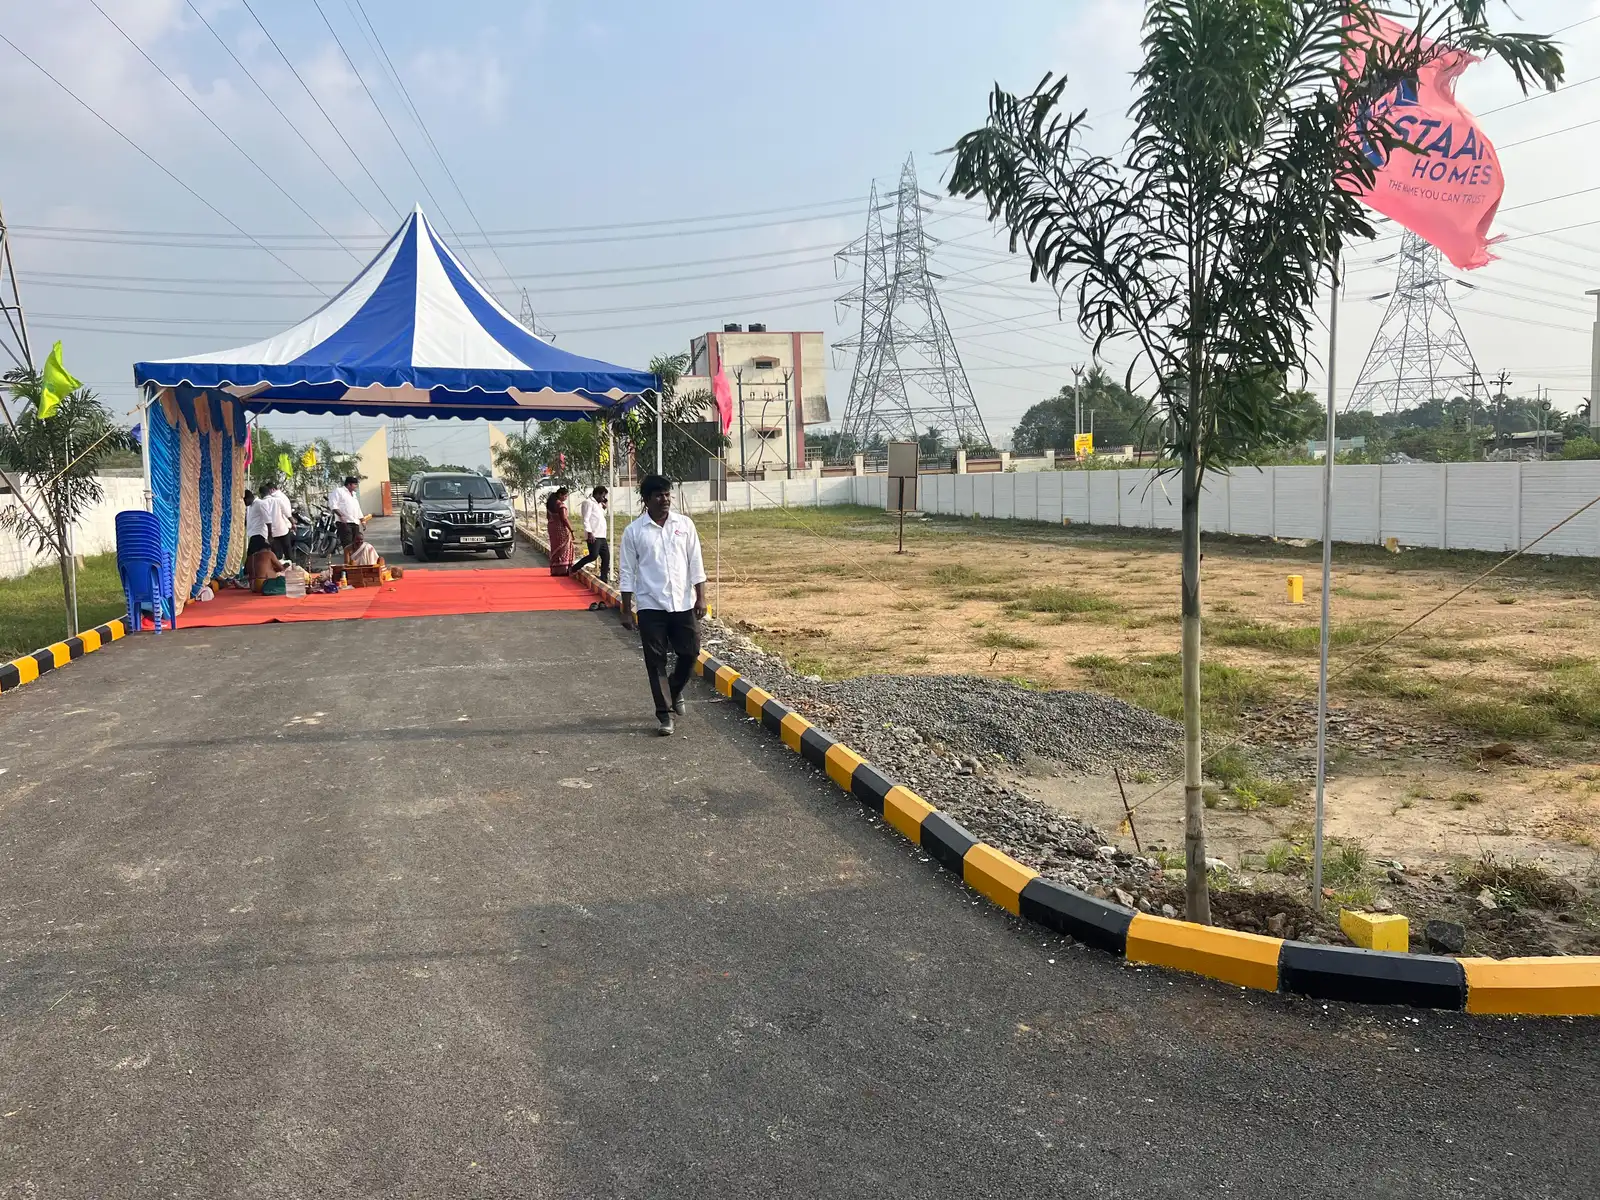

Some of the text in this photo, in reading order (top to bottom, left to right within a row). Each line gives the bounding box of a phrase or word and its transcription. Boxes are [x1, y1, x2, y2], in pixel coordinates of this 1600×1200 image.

[1412, 159, 1493, 185] HOMES
[1388, 179, 1402, 191] THE
[1420, 188, 1440, 200] YOU
[1441, 192, 1461, 203] CAN
[1462, 193, 1486, 205] TRUST
